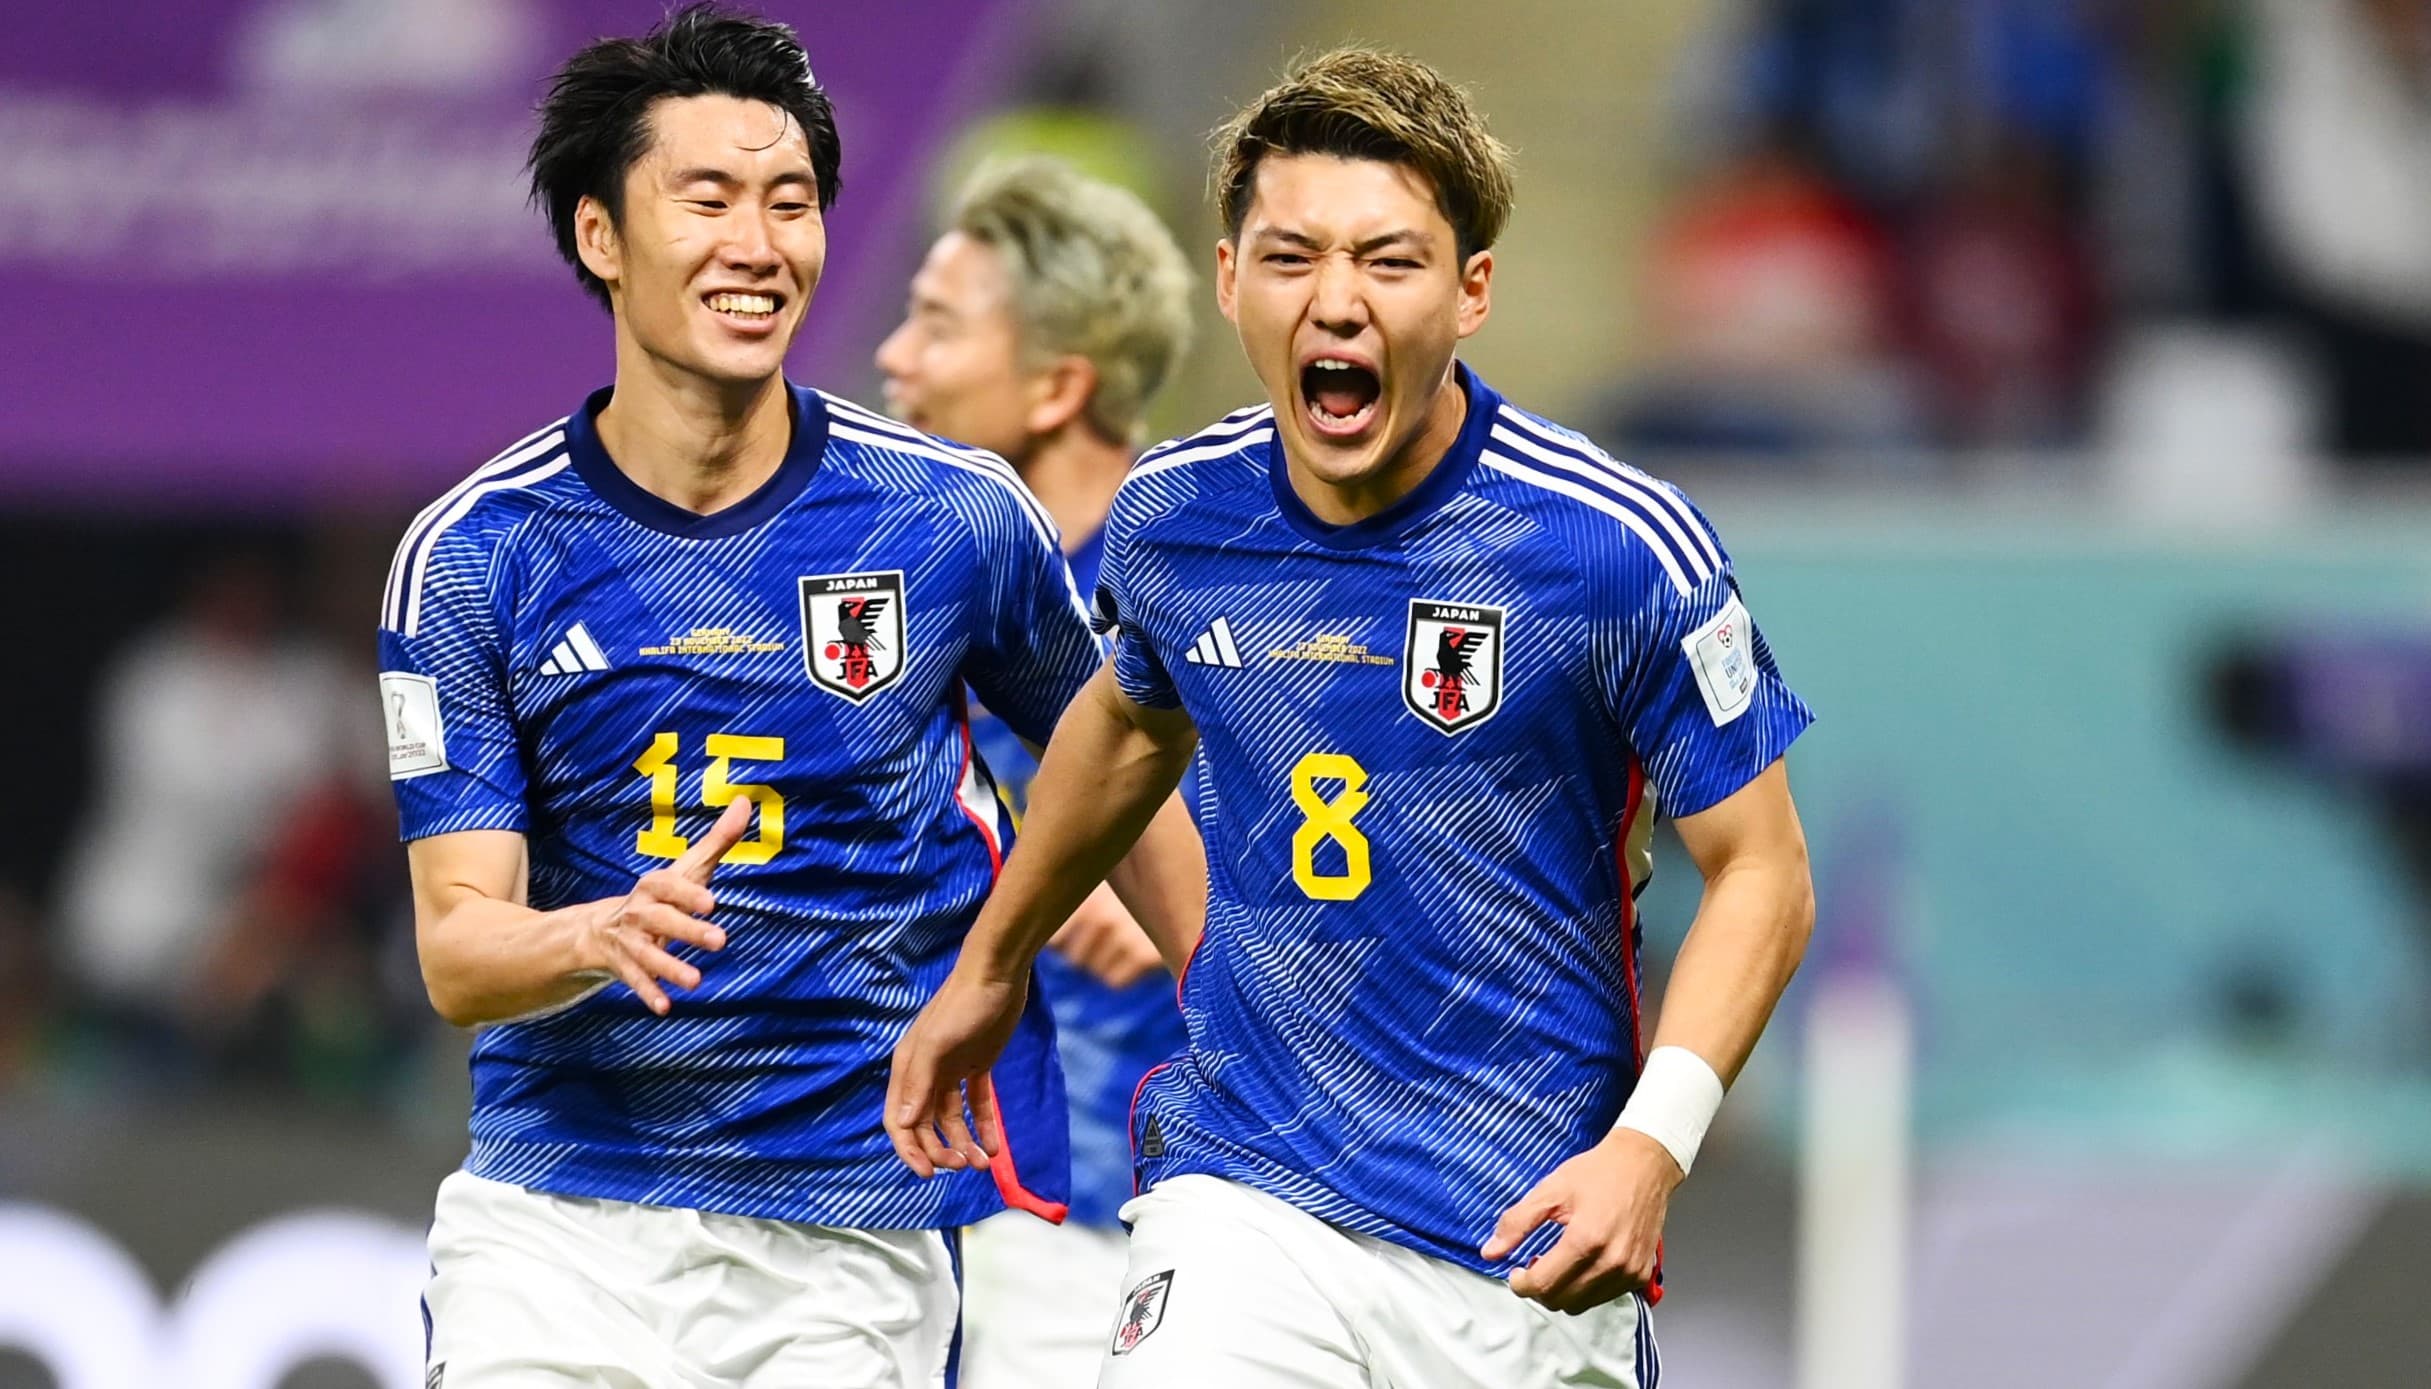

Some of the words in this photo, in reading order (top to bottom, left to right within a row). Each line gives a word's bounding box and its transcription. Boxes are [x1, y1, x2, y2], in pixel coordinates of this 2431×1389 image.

[826, 577, 877, 591] JAPAN
[1432, 607, 1480, 621] JAPAN
[836, 660, 878, 680] JFA
[1361, 654, 1395, 666] STADIUM
[1428, 691, 1470, 712] JFA
[632, 732, 784, 865] 15
[1291, 752, 1372, 901] 8
